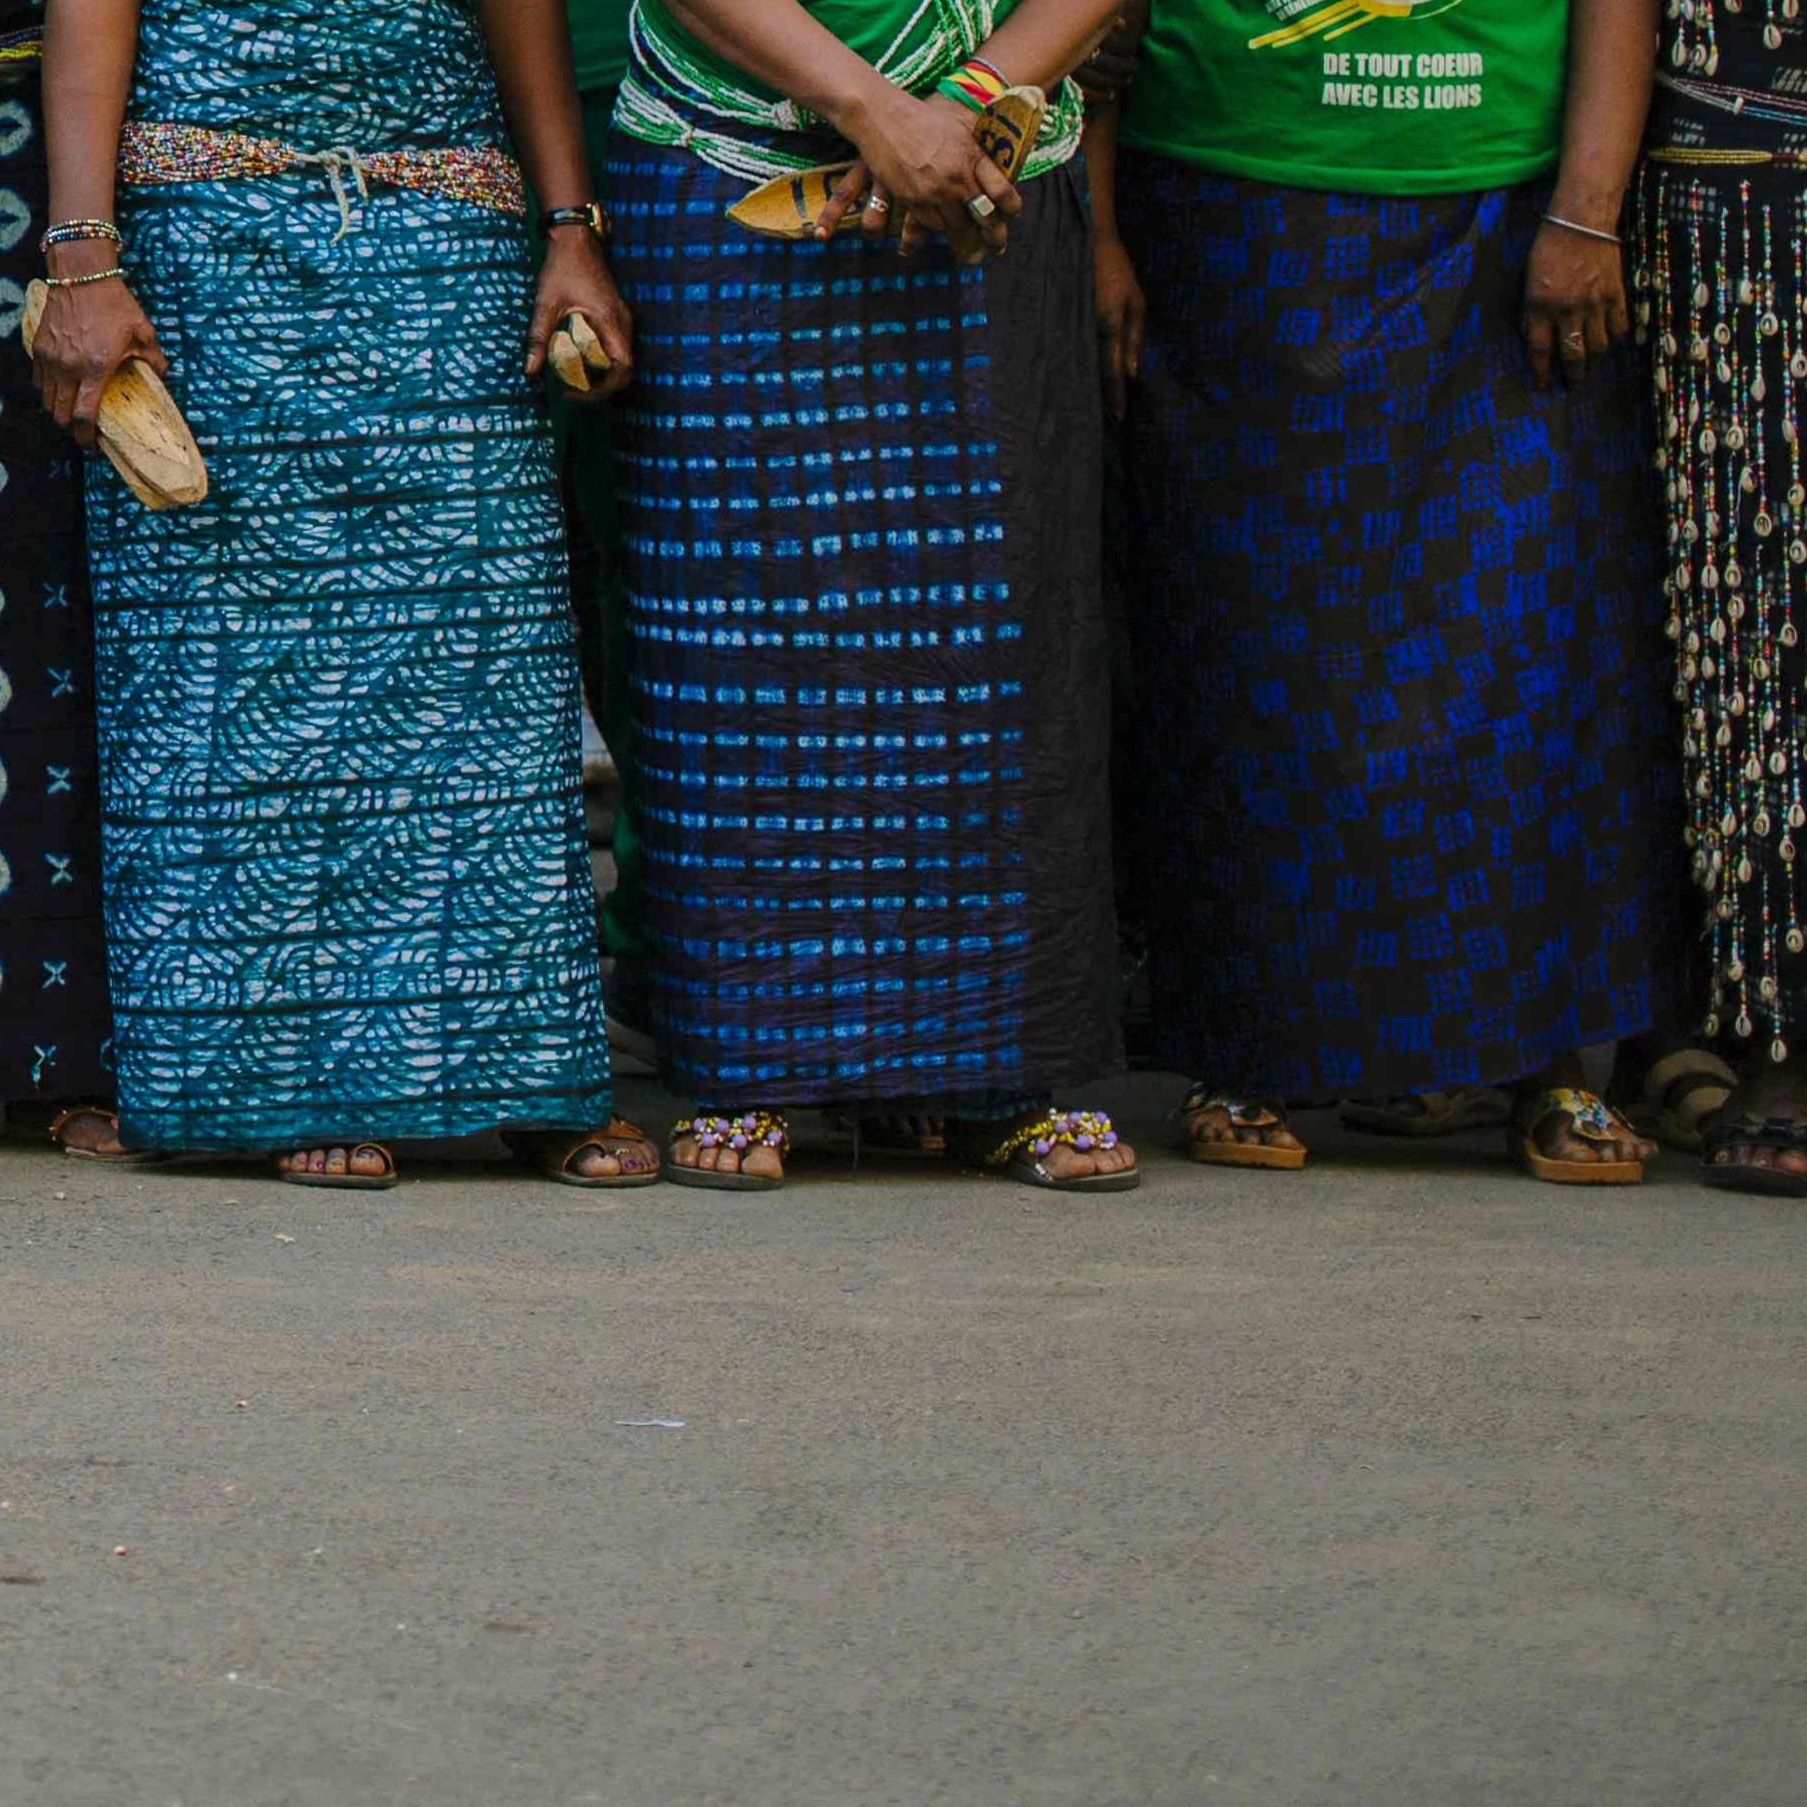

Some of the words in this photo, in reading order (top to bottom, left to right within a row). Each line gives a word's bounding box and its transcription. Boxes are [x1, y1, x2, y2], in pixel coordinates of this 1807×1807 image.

[1323, 52, 1351, 76] DE
[1354, 53, 1412, 78] TOUT
[1416, 52, 1484, 78] COEUR
[1322, 81, 1379, 108] AVEC
[1382, 85, 1419, 110] LES
[1423, 83, 1483, 110] LIONS
